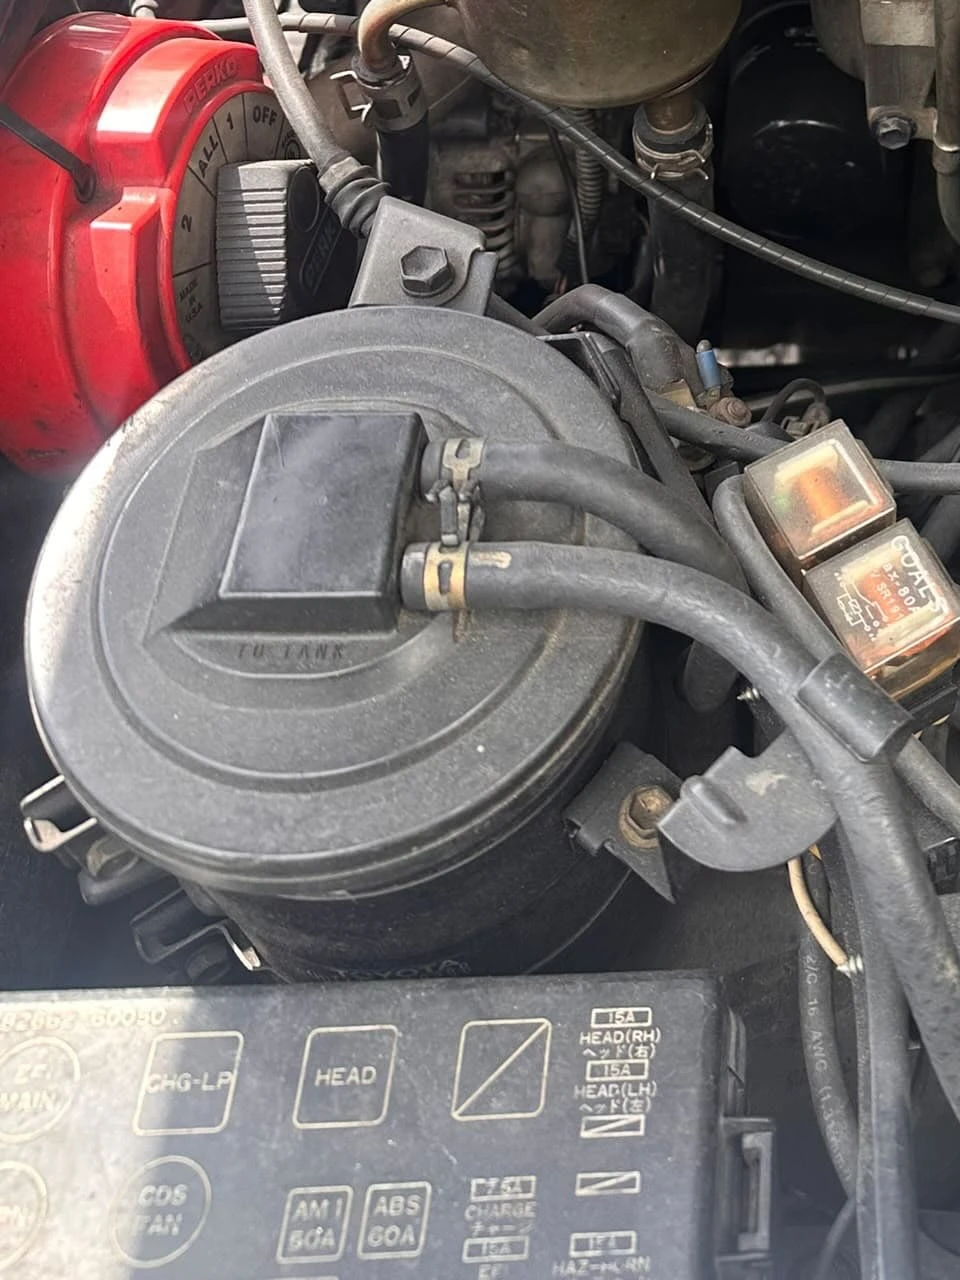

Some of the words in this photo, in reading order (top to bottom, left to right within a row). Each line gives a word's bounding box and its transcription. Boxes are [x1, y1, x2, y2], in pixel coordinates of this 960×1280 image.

[183, 55, 239, 113] PERKO
[226, 112, 235, 131] 1
[252, 105, 278, 127] OFF
[199, 135, 219, 179] ALL
[181, 214, 193, 233] 2
[890, 535, 949, 617] GOALS
[283, 642, 346, 660] TANK
[805, 954, 818, 986] 2/C
[607, 1011, 636, 1024] 15A
[807, 997, 819, 1017] 16
[579, 1028, 662, 1045] HEAD(RH)
[810, 1029, 828, 1072] AWG
[314, 1065, 378, 1087] HEAD
[602, 1064, 632, 1077] 15A
[145, 1070, 235, 1094] CHG-LP
[573, 1081, 657, 1099] HEAD(LH)
[137, 1184, 189, 1207] CDS
[372, 1194, 422, 1217] ABS
[464, 1201, 537, 1221] CHARGE
[367, 1224, 416, 1248] 60A
